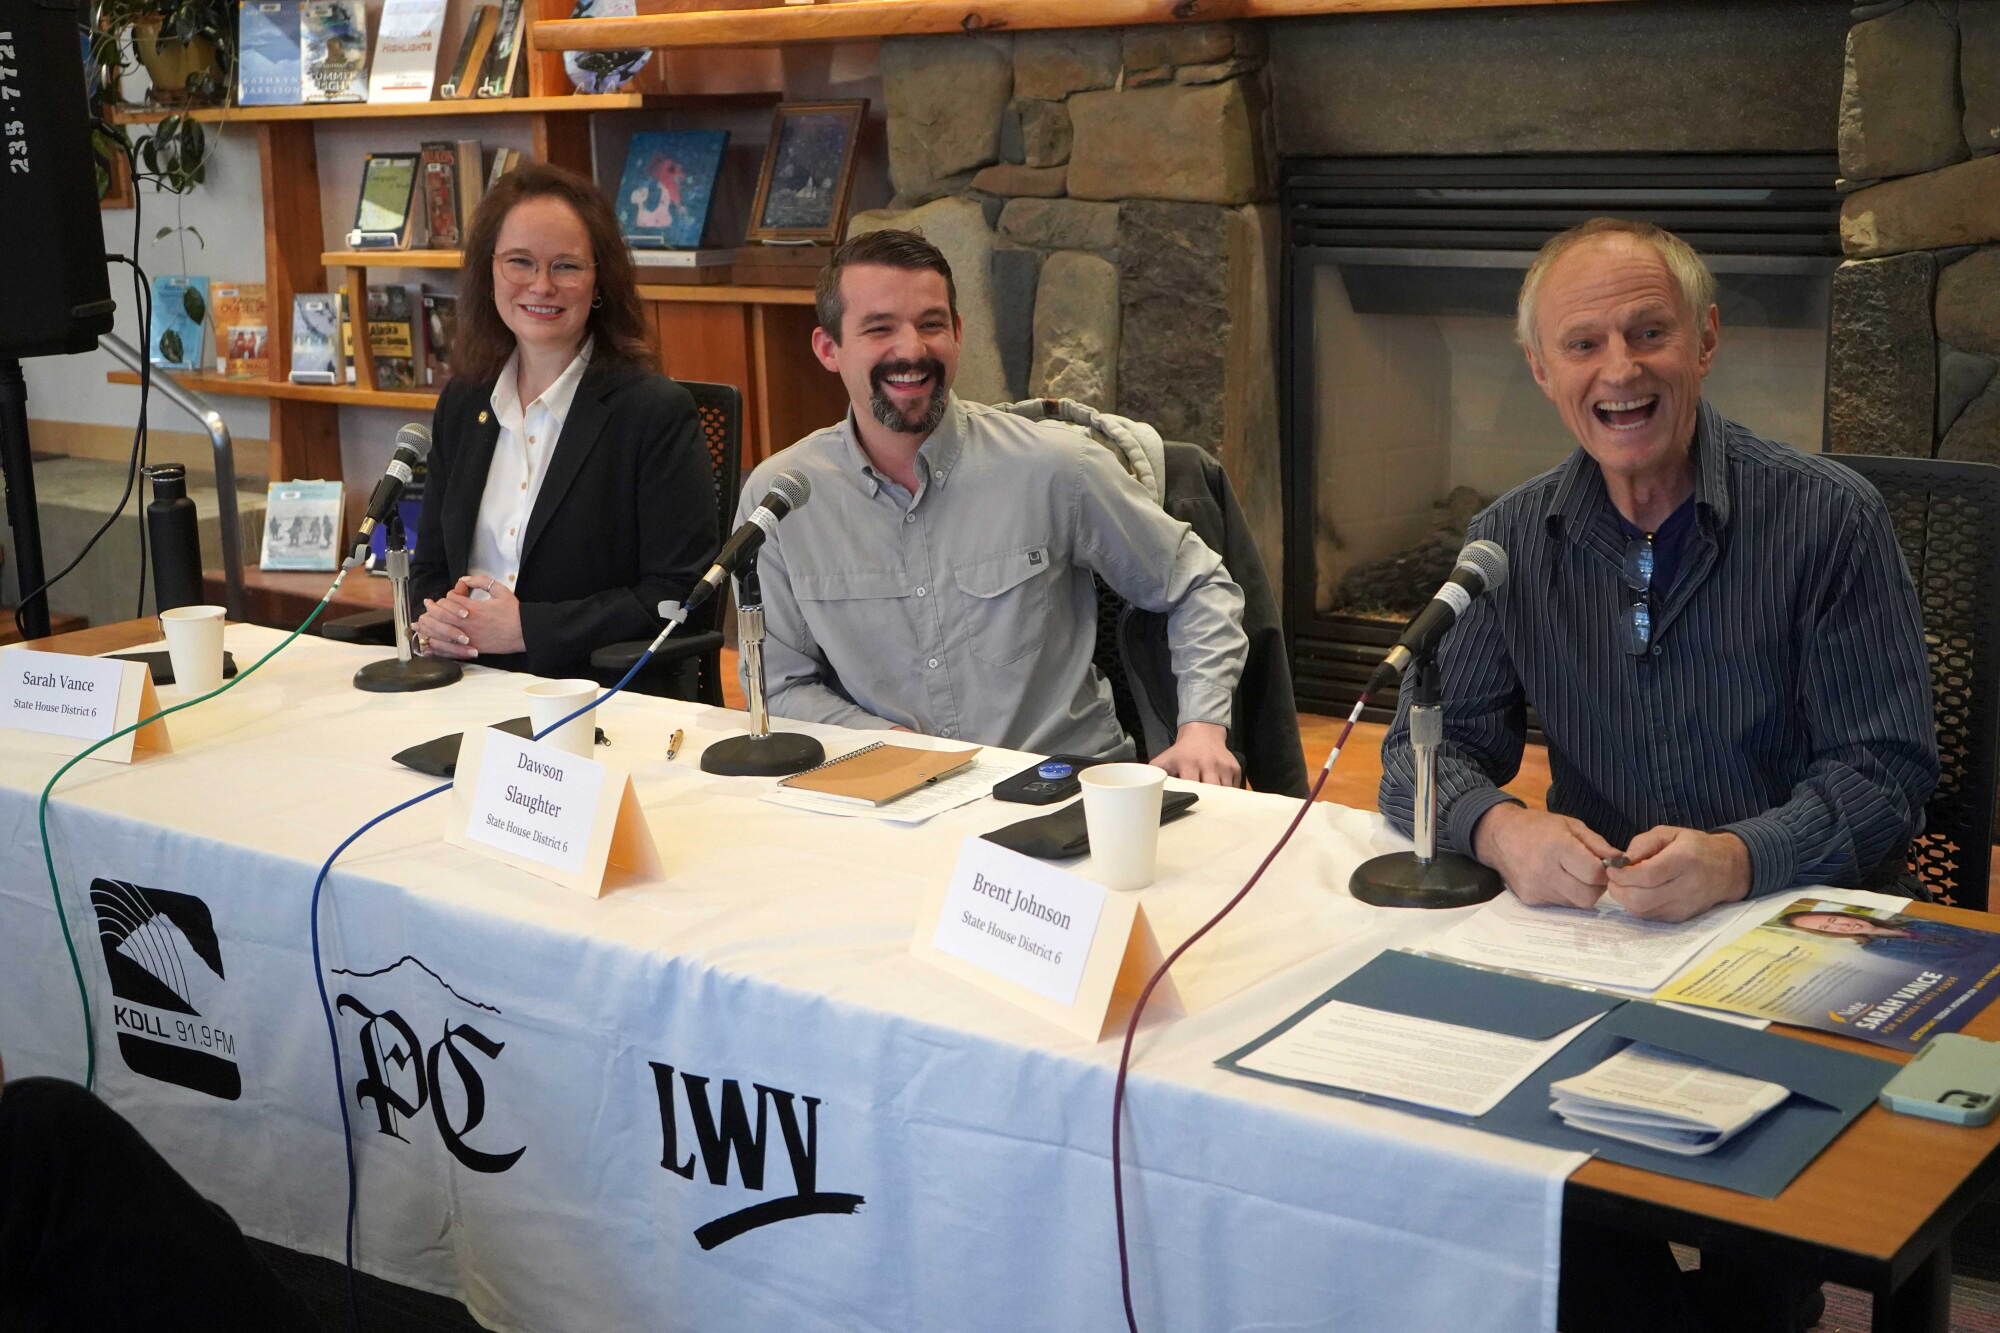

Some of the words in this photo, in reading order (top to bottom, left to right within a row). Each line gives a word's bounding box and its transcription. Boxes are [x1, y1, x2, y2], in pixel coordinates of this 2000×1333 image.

[22, 671, 56, 688] Sarah
[60, 674, 95, 692] Vance
[13, 698, 34, 710] State
[35, 701, 60, 713] House
[61, 703, 90, 717] District
[91, 707, 97, 717] 6
[517, 752, 564, 782] Dawson
[505, 784, 562, 818] Slaughter
[486, 813, 505, 830] State
[506, 820, 531, 839] House
[532, 829, 561, 851] District
[562, 841, 568, 853] 6
[972, 872, 1012, 904] Brent
[1011, 889, 1071, 930] Johnson
[961, 910, 986, 932] State
[987, 921, 1017, 945] House
[1018, 934, 1053, 961] District
[1054, 951, 1062, 965] 6
[1855, 998, 1907, 1030] SARAH
[1892, 970, 1944, 999] VANCE
[114, 1005, 171, 1038] KDLL
[648, 1061, 822, 1196] LWV
